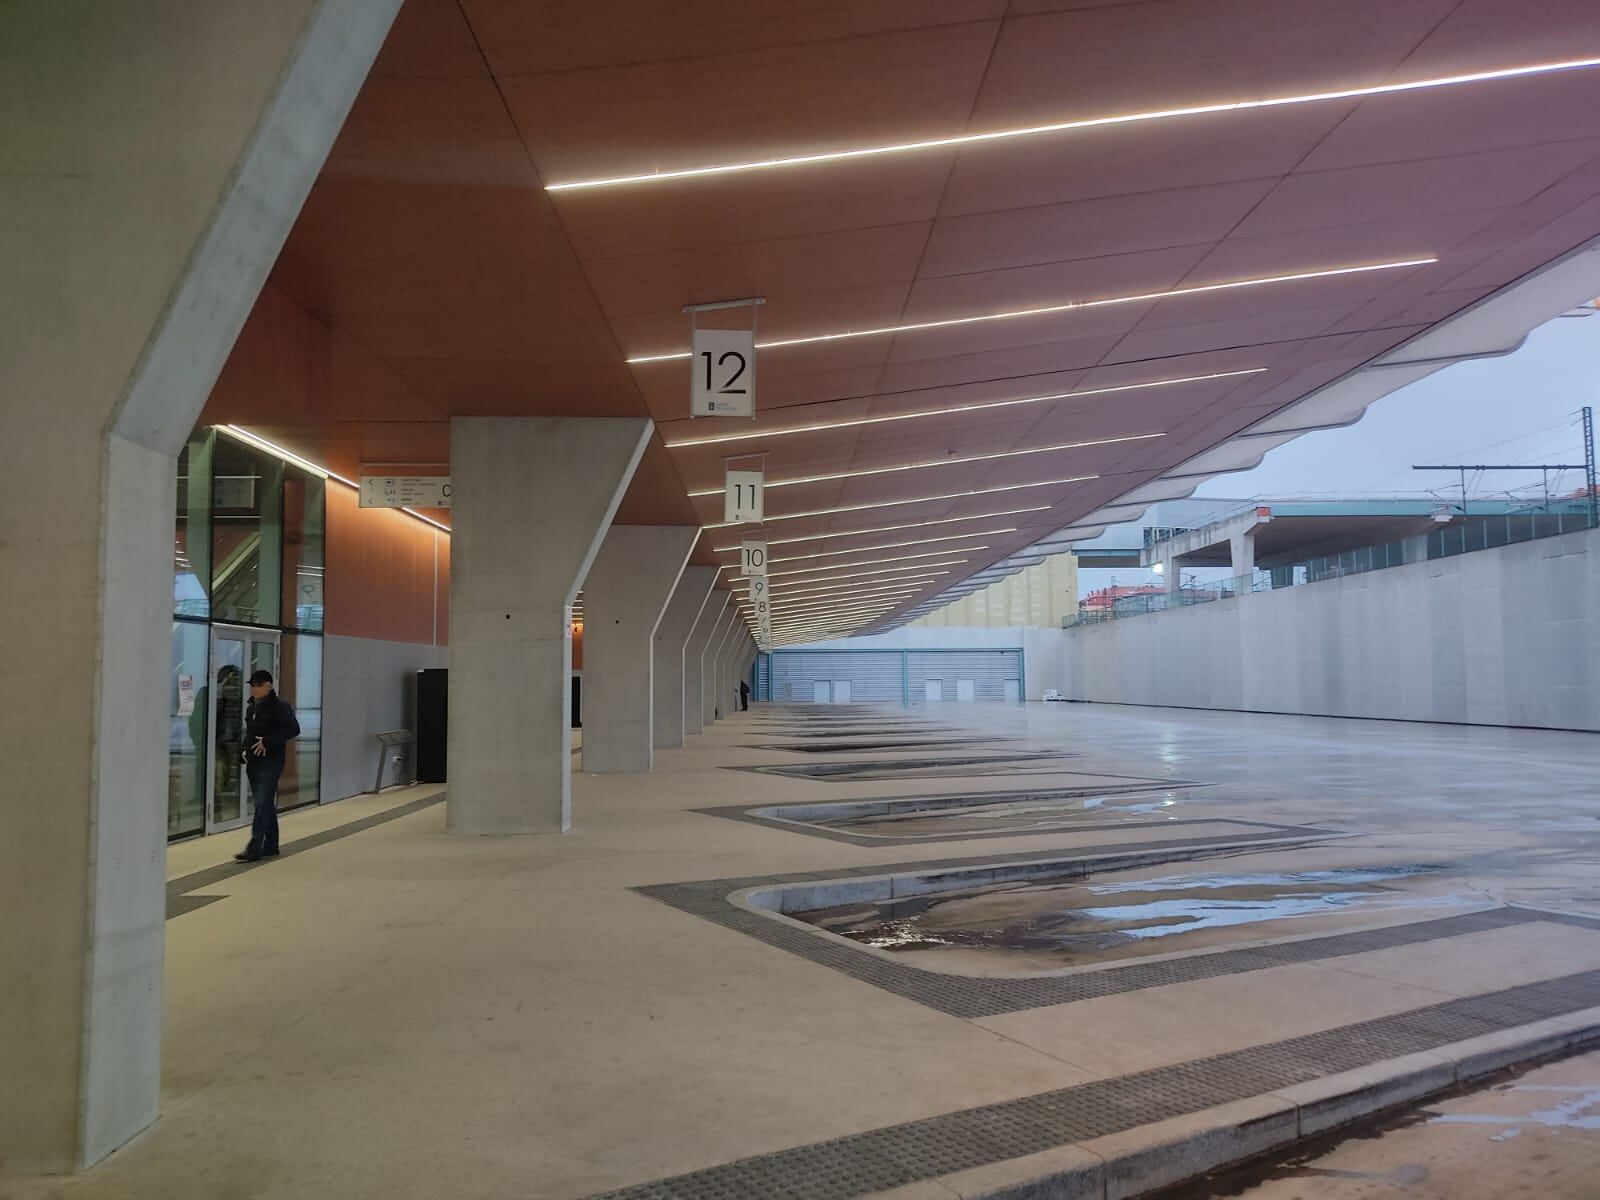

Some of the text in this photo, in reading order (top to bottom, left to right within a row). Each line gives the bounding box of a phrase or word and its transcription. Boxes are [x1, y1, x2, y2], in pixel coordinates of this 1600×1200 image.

[701, 351, 746, 394] 12
[735, 484, 755, 510] 11
[745, 549, 763, 567] 10
[755, 582, 763, 595] 9
[759, 602, 766, 612] 8
